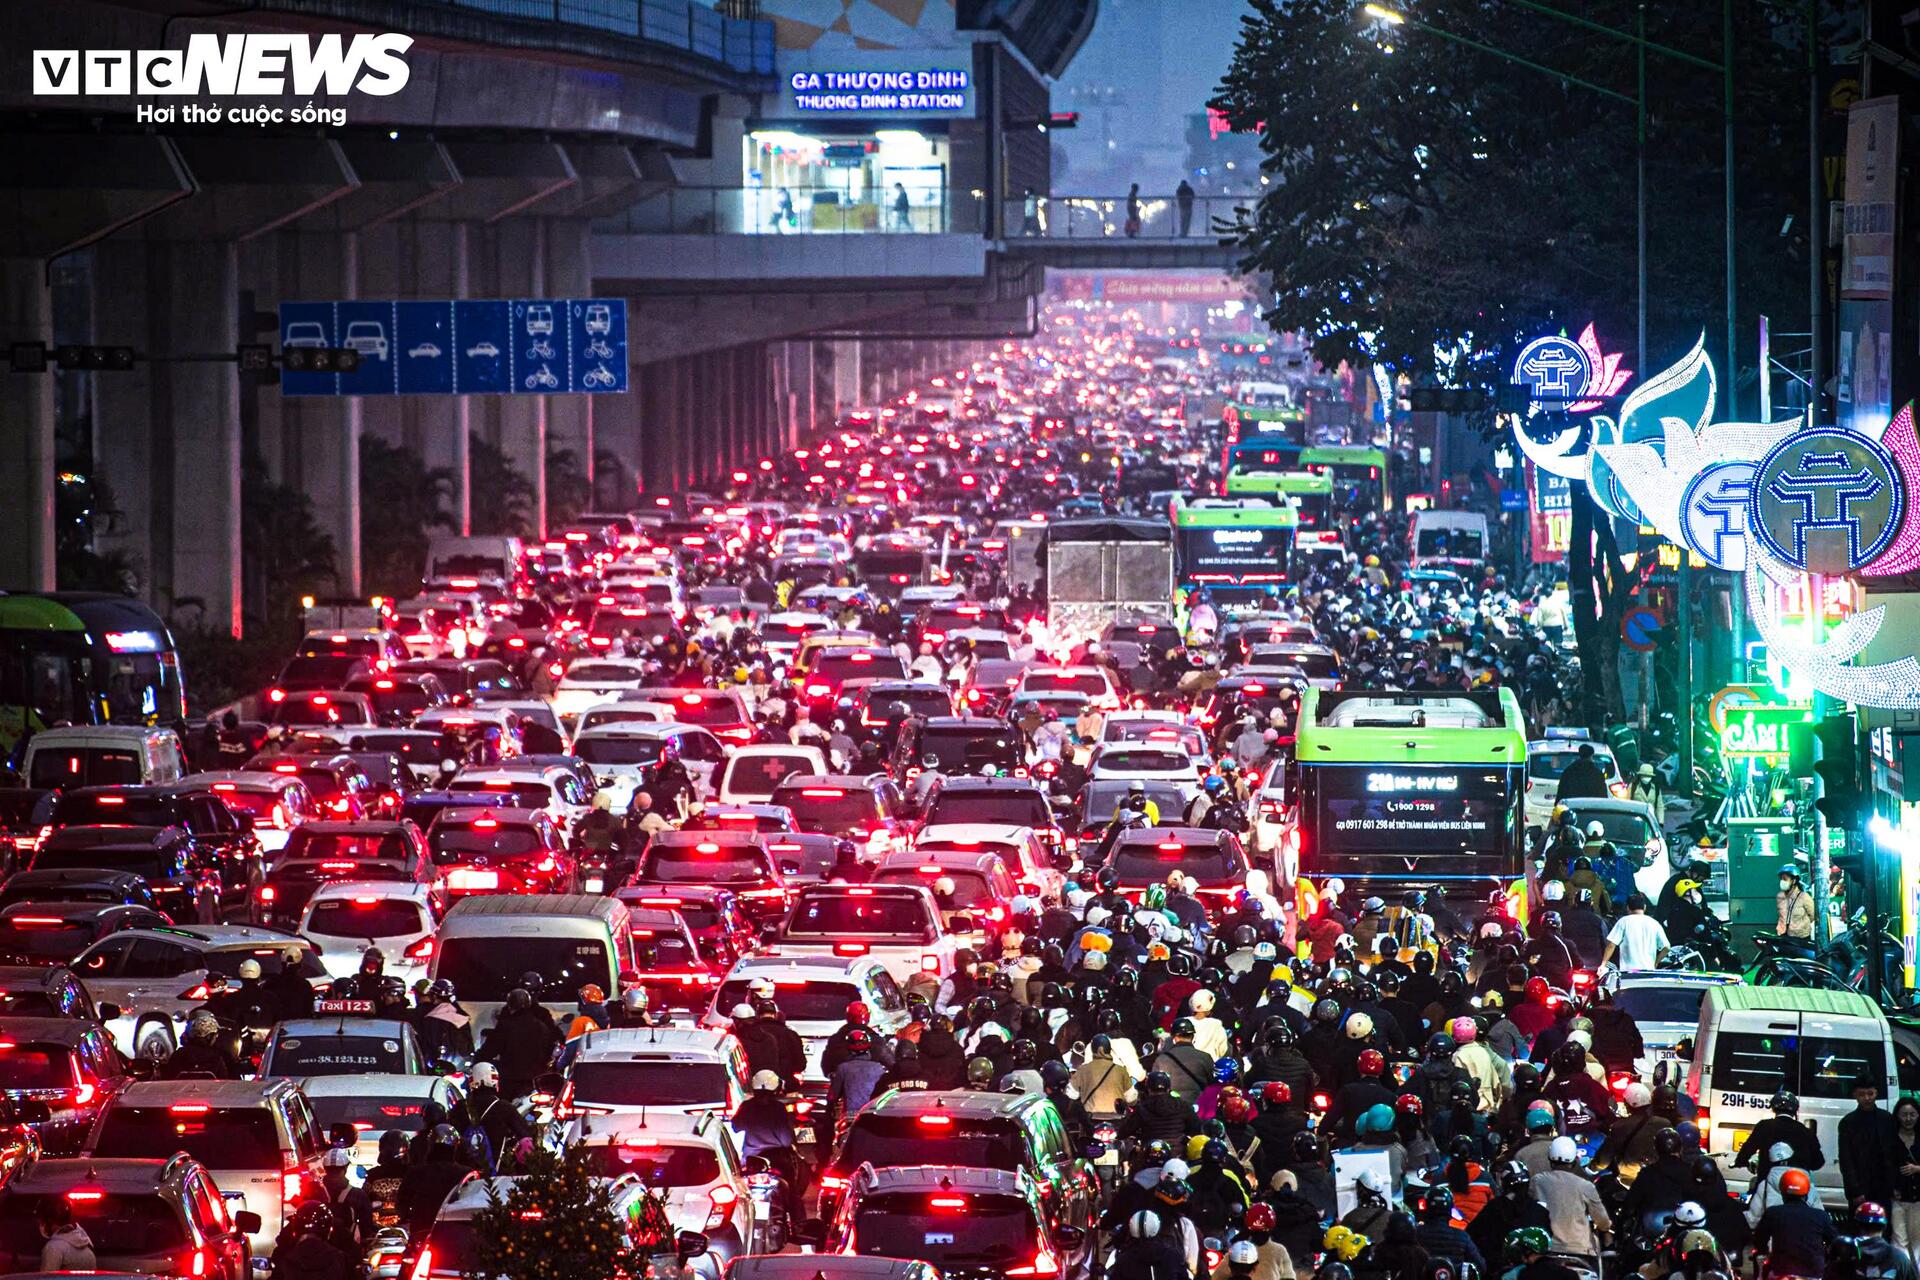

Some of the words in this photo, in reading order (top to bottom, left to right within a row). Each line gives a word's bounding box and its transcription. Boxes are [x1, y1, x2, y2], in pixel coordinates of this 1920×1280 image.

[791, 73, 821, 90] GA
[824, 71, 914, 93] THƯỢNG
[795, 95, 859, 110] THUONG
[860, 95, 898, 109] DINH
[899, 94, 964, 109] STATION
[1394, 803, 1414, 811] 1900
[1415, 803, 1436, 811] 1298
[1346, 819, 1362, 830] 0917
[1362, 819, 1375, 830] 601
[1376, 819, 1388, 830] 298
[1450, 820, 1461, 830] BUS
[320, 1001, 344, 1011] Taxi
[346, 1001, 372, 1011] 123
